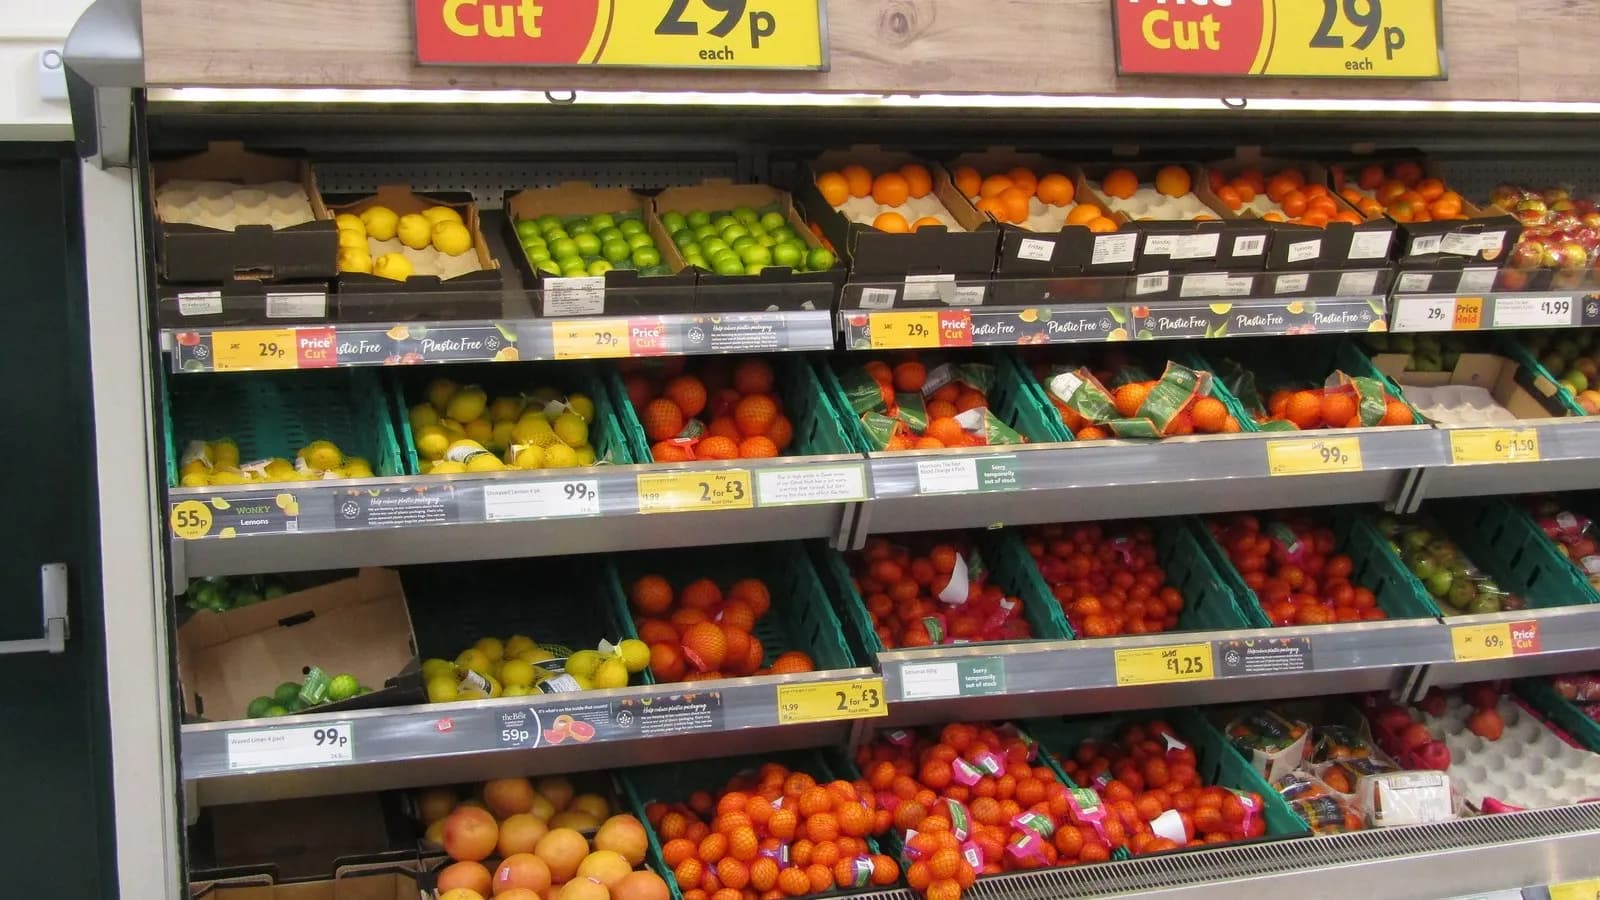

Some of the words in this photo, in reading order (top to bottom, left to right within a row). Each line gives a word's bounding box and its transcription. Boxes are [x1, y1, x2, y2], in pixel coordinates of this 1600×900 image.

[443, 0, 543, 38] Cut
[654, 0, 777, 48] 29p
[1142, 10, 1220, 50] Cut
[1308, 0, 1405, 60] 29p
[698, 45, 734, 60] each
[1344, 58, 1373, 70] each
[1427, 307, 1445, 320] 29p
[1456, 304, 1478, 314] Price
[1541, 301, 1569, 315] £1.99
[941, 319, 965, 330] Price
[1158, 317, 1189, 331] Plastic
[1189, 318, 1206, 328] Free
[1236, 314, 1267, 328] Plastic
[1267, 316, 1284, 325] Free
[1312, 312, 1341, 325] Plastic
[1341, 313, 1358, 322] Free
[632, 328, 659, 338] Price
[908, 323, 929, 337] 29p
[997, 322, 1016, 334] Free
[1049, 320, 1079, 333] Plastic
[1079, 321, 1097, 331] Free
[594, 332, 618, 347] 29p
[945, 329, 963, 339] Cut
[259, 343, 285, 358] 29p
[301, 338, 330, 349] Price
[360, 341, 382, 354] Free
[422, 338, 461, 354] Plastic
[461, 339, 482, 350] Free
[304, 349, 326, 359] Cut
[1495, 440, 1502, 452] 6
[1320, 447, 1348, 465] 99p
[563, 483, 595, 501] 99p
[698, 482, 711, 502] 2
[713, 489, 724, 497] for
[725, 480, 745, 500] £3
[177, 509, 208, 529] 55p
[240, 518, 269, 526] Lemons
[1485, 635, 1504, 649] 69p
[1513, 630, 1536, 640] Price
[1517, 639, 1533, 649] Cut
[972, 667, 987, 675] Sorry
[1167, 656, 1203, 675] £1.25
[836, 691, 848, 710] 2
[849, 698, 860, 706] for
[862, 688, 880, 708] £3
[502, 713, 513, 721] the
[512, 711, 527, 720] Best
[314, 728, 347, 748] 99p
[502, 728, 529, 742] 59p
